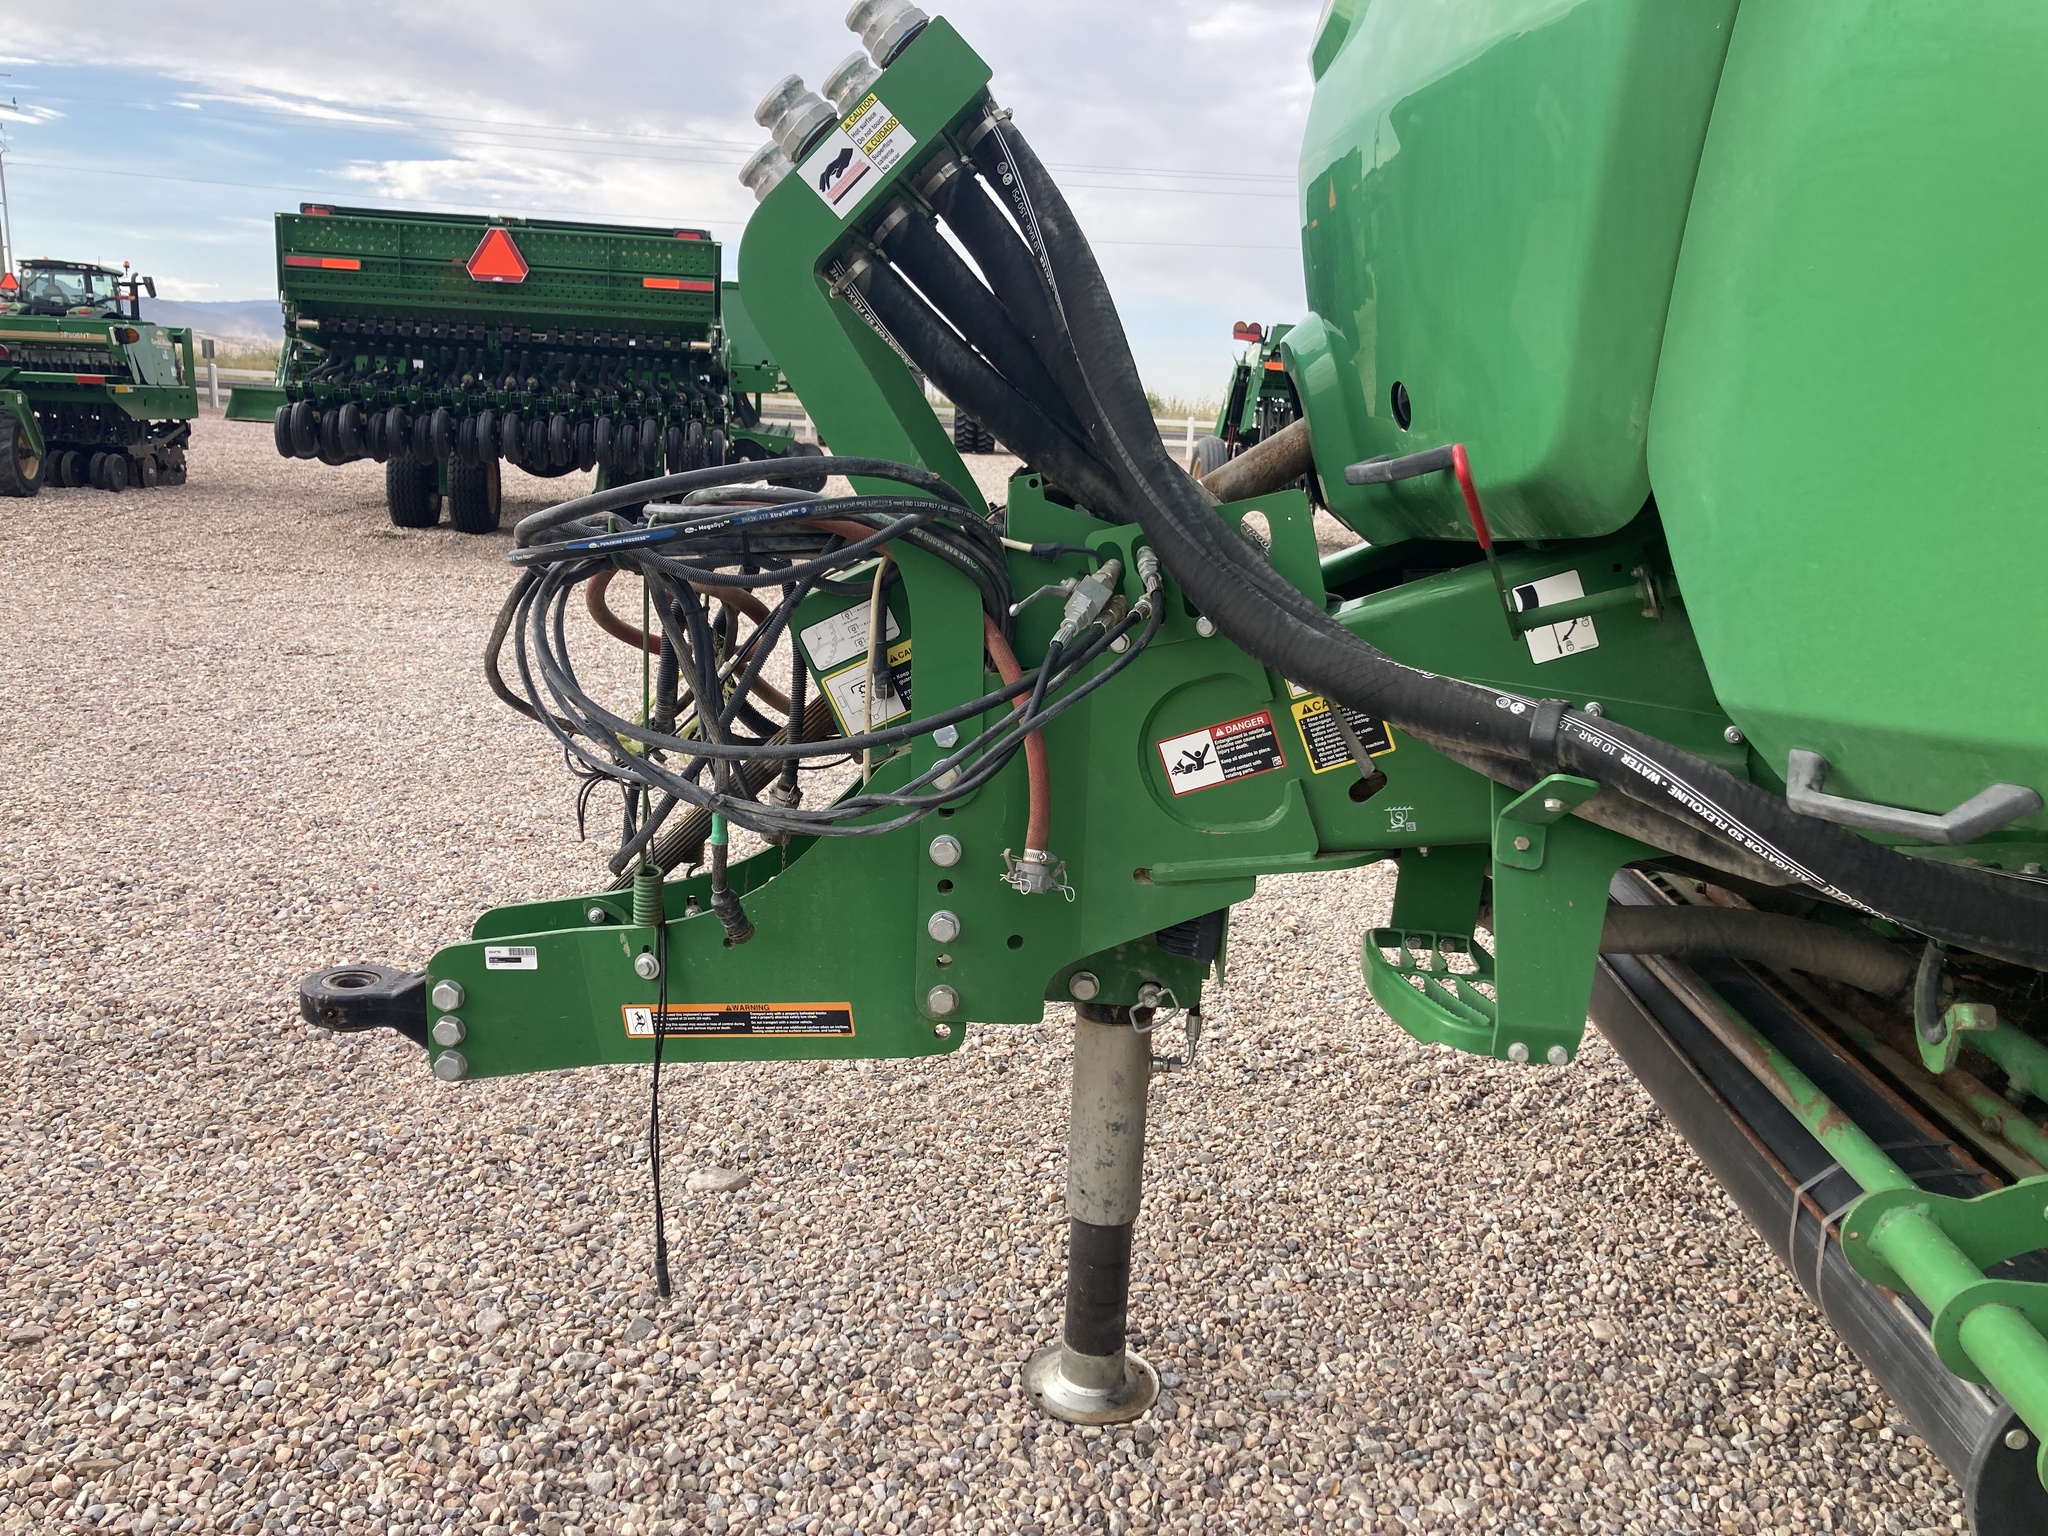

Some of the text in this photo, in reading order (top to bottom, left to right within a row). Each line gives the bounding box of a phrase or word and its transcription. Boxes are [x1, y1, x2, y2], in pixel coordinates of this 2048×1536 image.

[849, 95, 875, 123] CAUTION
[851, 112, 877, 138] Hot surface
[856, 115, 885, 145] Do not touch
[871, 119, 897, 146] CUIDADO
[872, 138, 893, 160] Superficie
[877, 148, 895, 165] caliente
[882, 152, 900, 171] No tocar
[1012, 187, 1024, 203] PSI
[1017, 202, 1028, 218] 150
[1026, 222, 1036, 241] BAR
[864, 313, 875, 325] SD
[944, 544, 958, 556] BAR
[896, 671, 909, 679] Keep
[1225, 716, 1264, 734] DANGER
[1214, 734, 1243, 745] Entanglement
[1216, 742, 1234, 750] driveline
[1578, 729, 1602, 748] BAR
[1601, 744, 1617, 755] 10
[1226, 771, 1242, 779] rotating
[1621, 753, 1661, 786] WATER
[1667, 785, 1731, 831] FLEXOLINE
[1728, 828, 1745, 841] SD
[1744, 840, 1811, 882] ALLIGATOR
